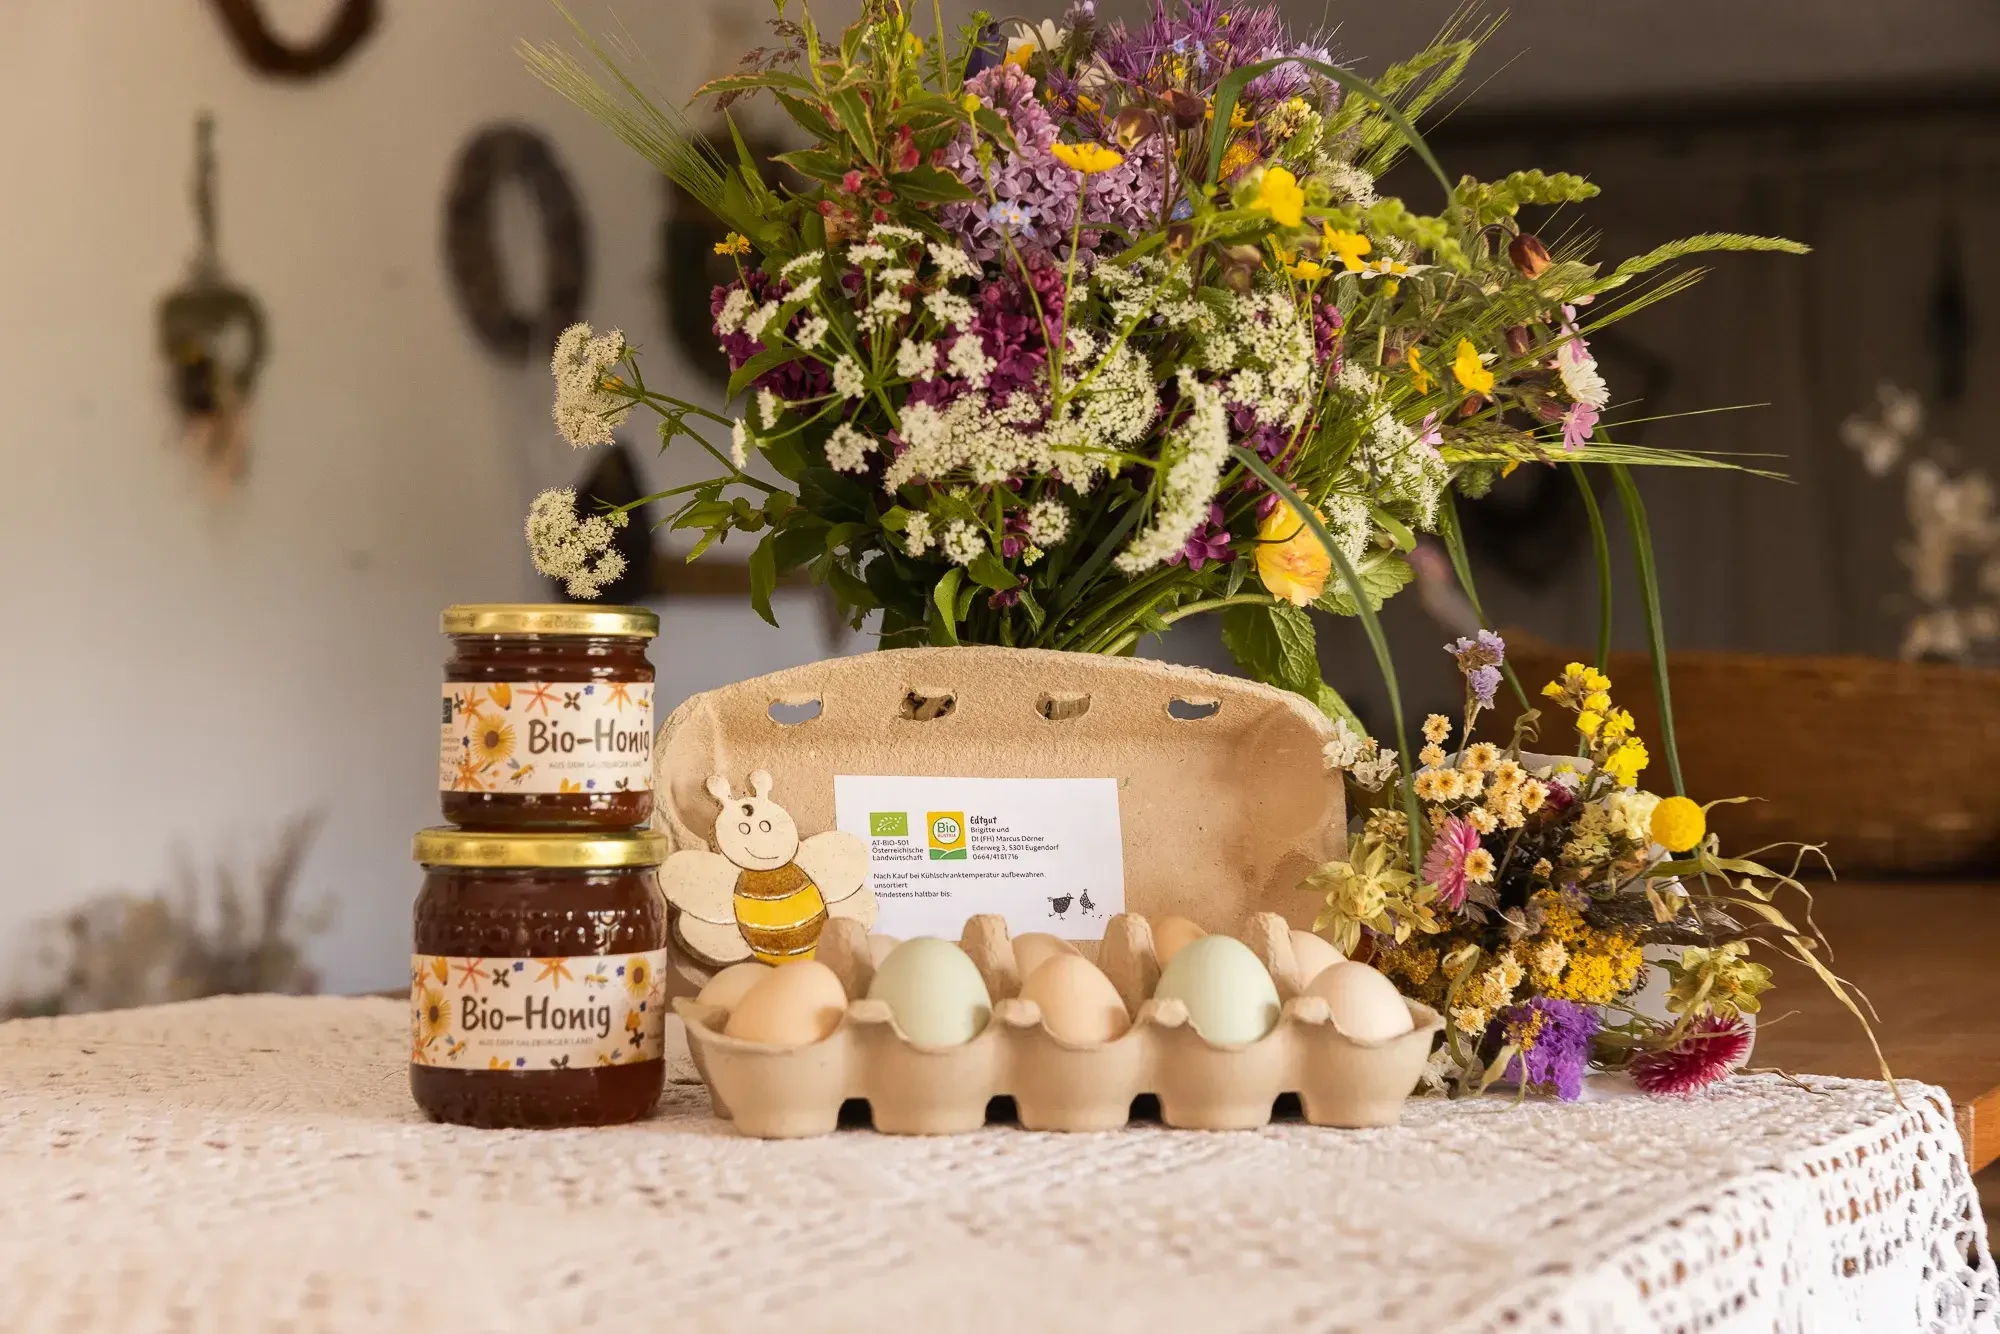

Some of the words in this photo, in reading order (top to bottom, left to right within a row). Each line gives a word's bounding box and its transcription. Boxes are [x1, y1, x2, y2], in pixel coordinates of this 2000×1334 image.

[528, 718, 650, 762] Bio-Honig
[970, 815, 998, 826] Edtgut
[937, 822, 956, 833] Bio
[1021, 834, 1045, 842] Dörner
[872, 846, 924, 854] Österreichische
[972, 844, 1001, 852] Ederweg
[1001, 844, 1008, 852] 3,
[1025, 844, 1060, 852] Eugendorf
[972, 853, 1019, 861] 0664/4181716
[873, 872, 892, 880] Nach
[920, 872, 1000, 880] Kühlschranktemperatur
[1000, 871, 1047, 879] aufbewahren.
[874, 890, 914, 898] Mindestens
[914, 890, 940, 898] haltbar
[940, 890, 952, 898] bis:
[460, 994, 611, 1039] Bio-Honig
